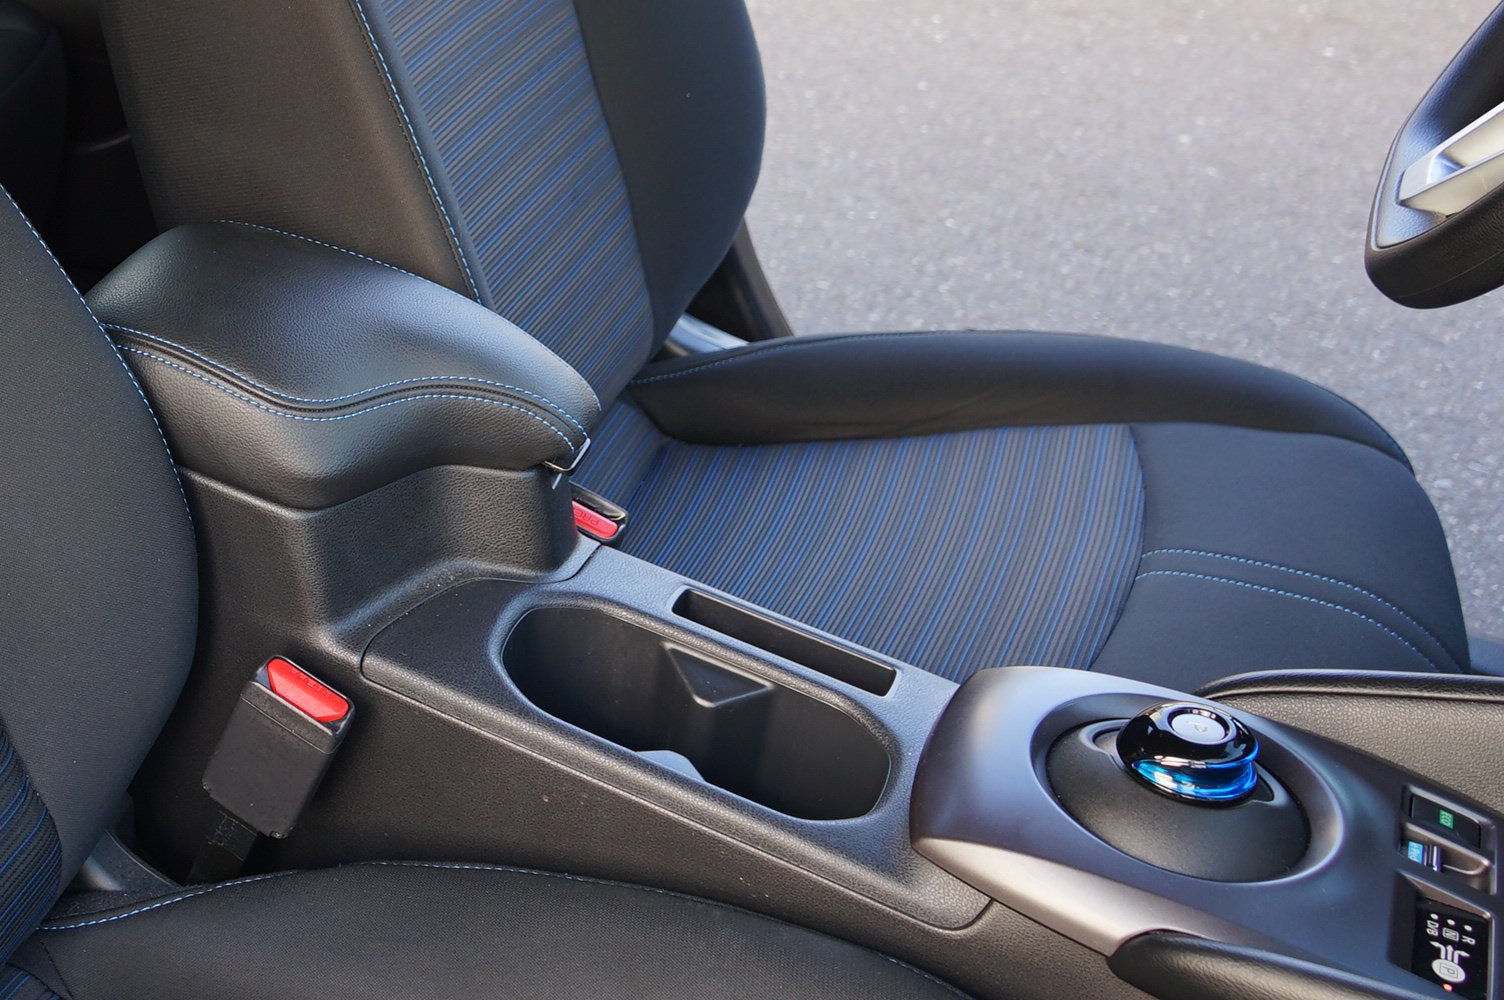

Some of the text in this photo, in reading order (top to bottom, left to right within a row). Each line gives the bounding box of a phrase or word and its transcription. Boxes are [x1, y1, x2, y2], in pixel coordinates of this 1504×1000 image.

[1440, 810, 1452, 827] ECO
[1426, 920, 1439, 936] D/B
[1462, 935, 1475, 945] R
